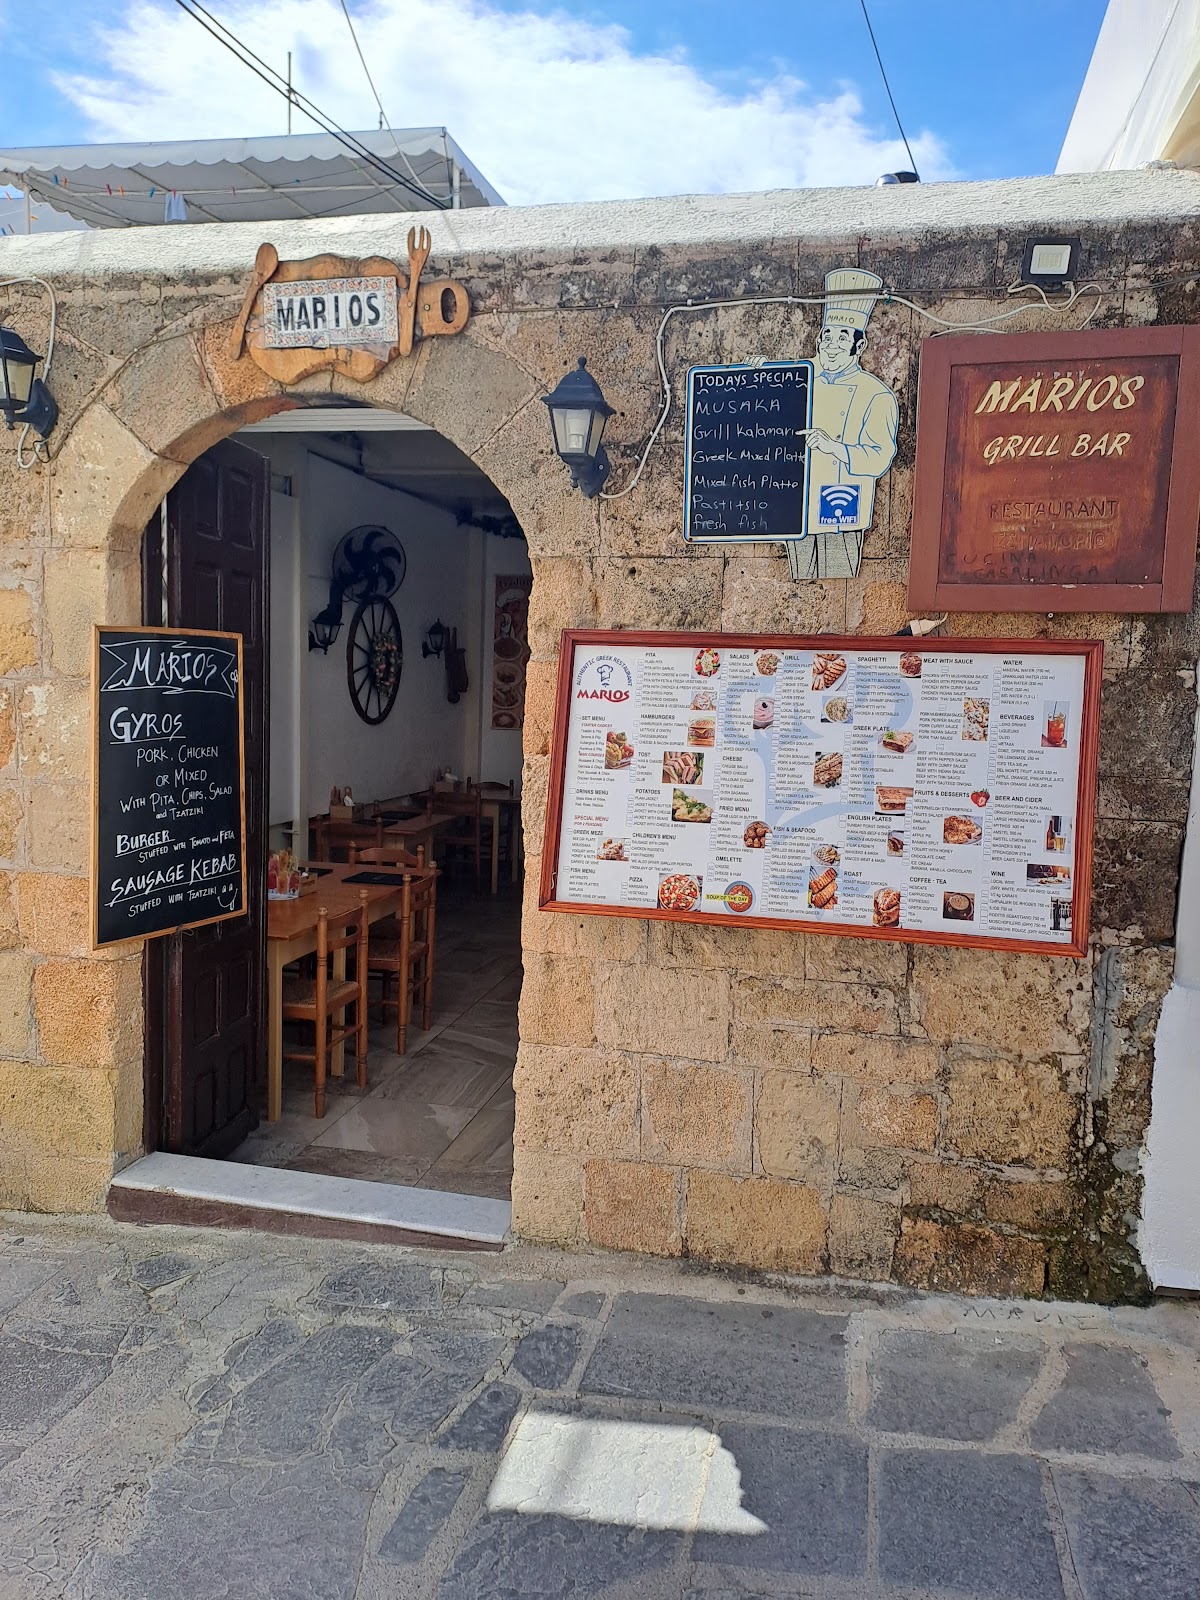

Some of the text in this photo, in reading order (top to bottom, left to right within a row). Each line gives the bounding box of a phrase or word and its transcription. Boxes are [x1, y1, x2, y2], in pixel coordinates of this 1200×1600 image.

[276, 292, 381, 332] MARIOS
[696, 372, 805, 388] TODAYS SPECIAL
[696, 398, 781, 416] MUSAKA
[974, 374, 1145, 414] MARIOS
[692, 448, 738, 463] Greek
[983, 432, 1132, 465] GRILL BAR
[839, 516, 856, 524] WIFI
[989, 500, 1120, 519] RESTAURANT
[108, 646, 218, 689] MARIOS
[576, 658, 596, 686] AUTHENTIC
[613, 656, 632, 686] RESTAURANT
[576, 689, 630, 702] MARIOS
[110, 706, 183, 742] GYROS
[178, 745, 219, 764] CHICKEN
[156, 768, 208, 788] OR MIXED
[120, 796, 146, 814] WITH
[208, 782, 233, 800] SALAD
[156, 806, 204, 820] and TZATZIKI
[116, 830, 171, 855] BURGER
[138, 846, 168, 864] STUFFED
[173, 842, 186, 852] WITH
[219, 830, 236, 844] FETA
[110, 854, 237, 907] SAUSAGE KEBAB
[128, 886, 217, 918] STUFFED WITH TZATZIKI
